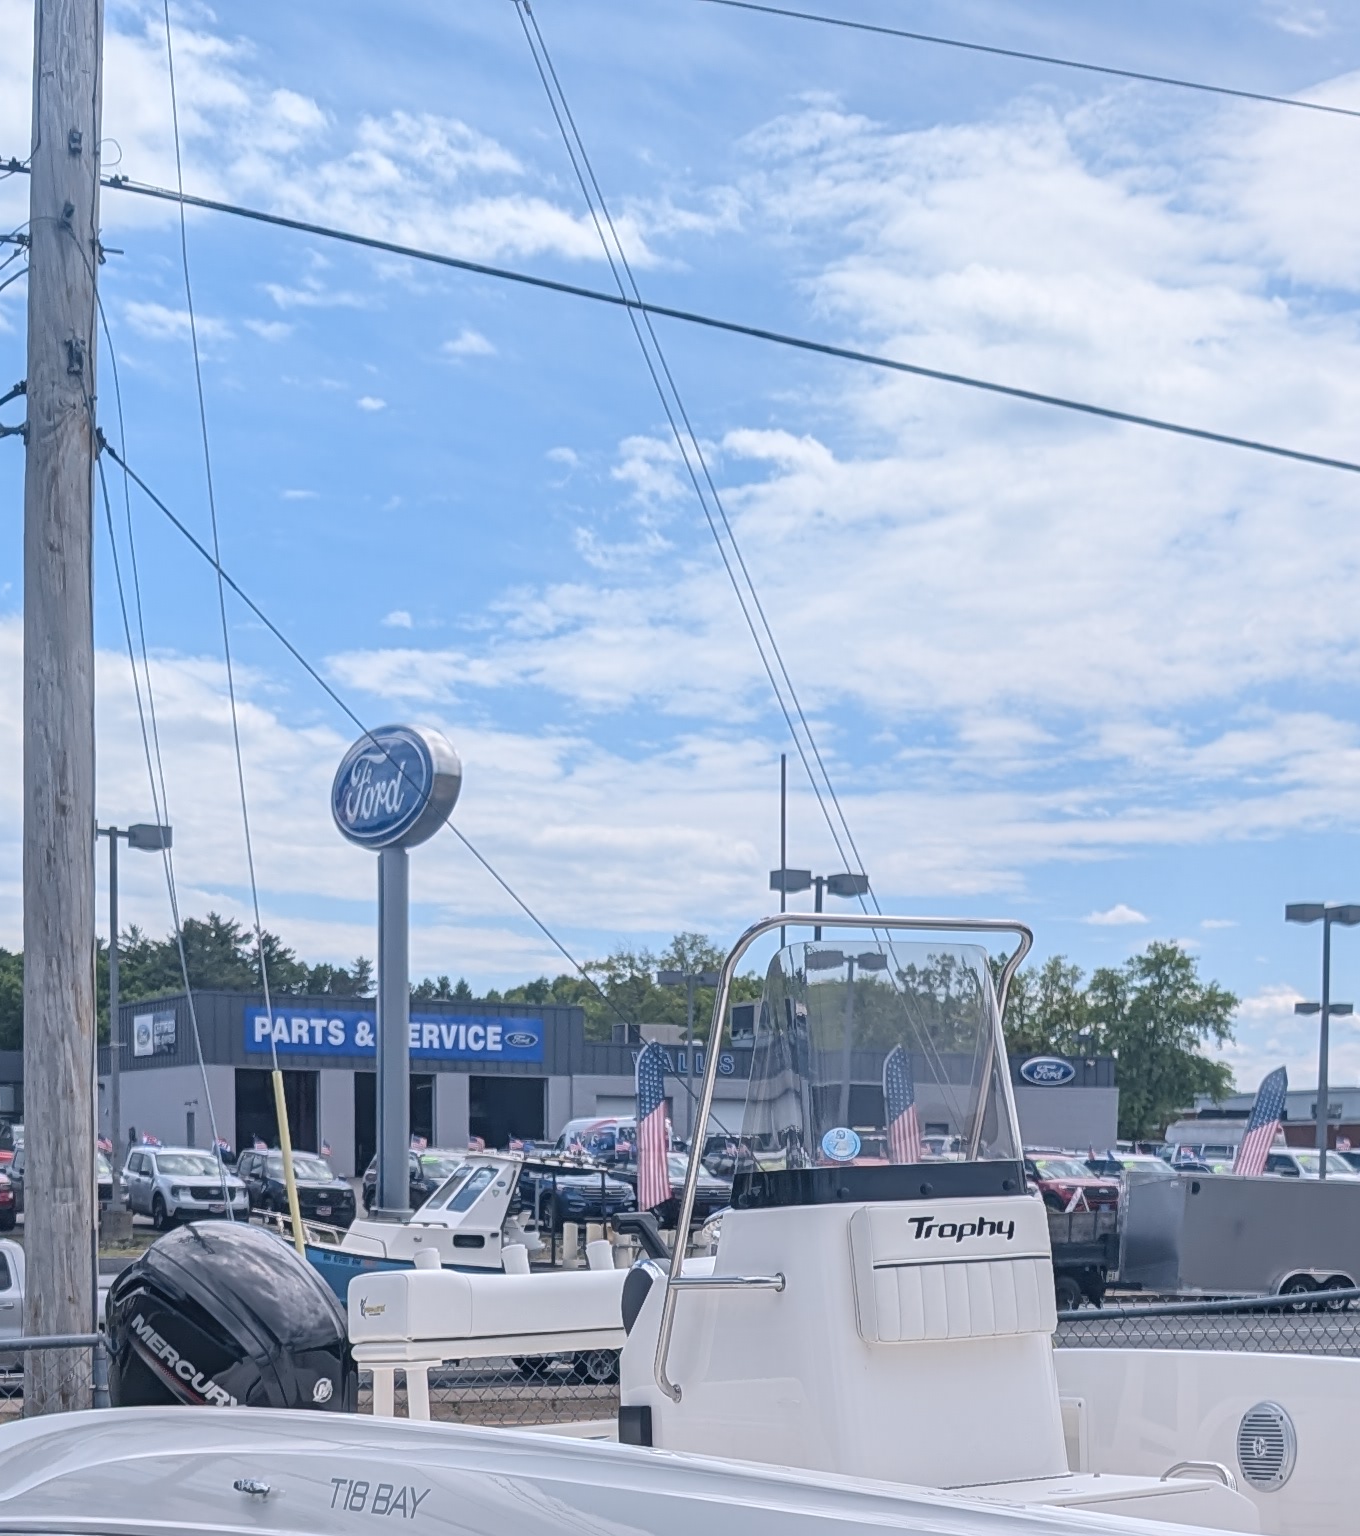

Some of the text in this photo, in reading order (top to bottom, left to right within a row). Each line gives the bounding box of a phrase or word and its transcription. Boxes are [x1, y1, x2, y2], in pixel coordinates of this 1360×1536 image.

[345, 749, 407, 825] Ford
[253, 1014, 504, 1052] PARTS & ERVICE
[1033, 1063, 1066, 1081] Ford
[908, 1216, 1015, 1243] Trophy
[330, 1477, 431, 1519] T18 BAY
